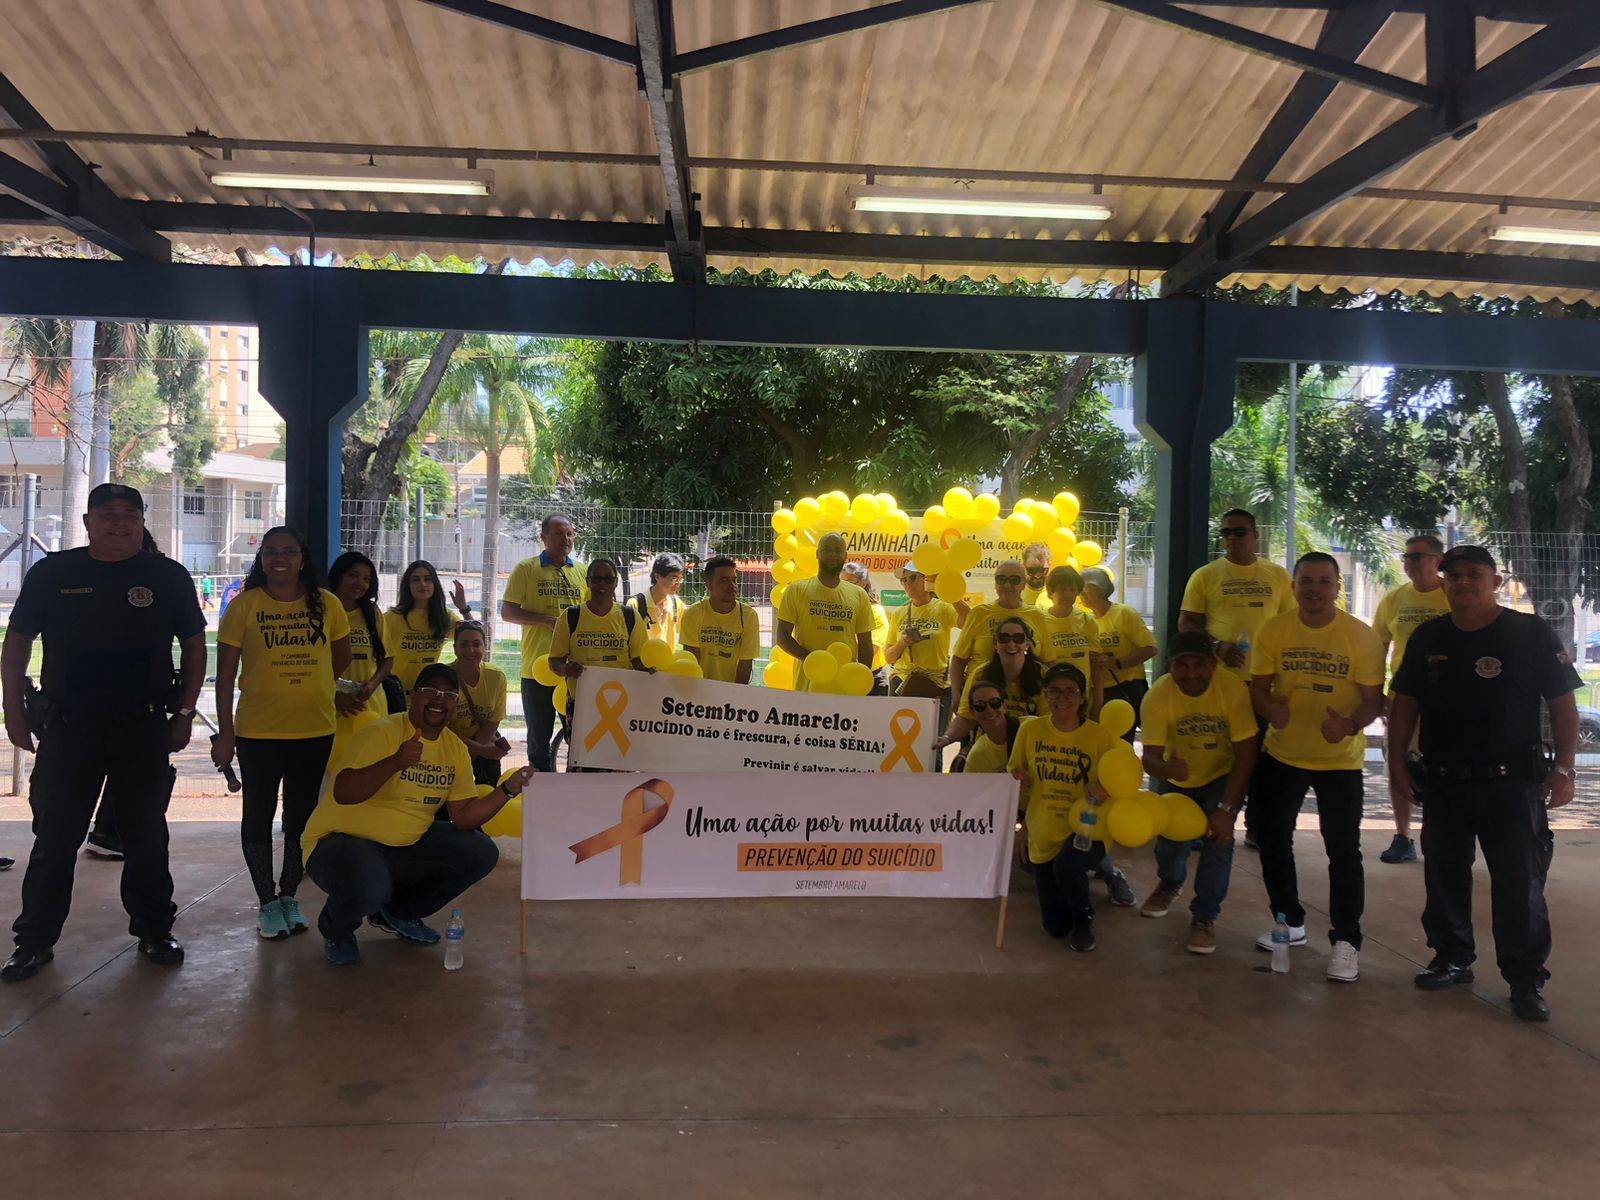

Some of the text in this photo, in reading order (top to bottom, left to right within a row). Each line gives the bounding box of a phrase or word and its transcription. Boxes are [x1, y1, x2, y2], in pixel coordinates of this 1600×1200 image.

[873, 558, 886, 570] DO
[256, 610, 283, 623] Uma
[264, 630, 311, 649] Vidas!
[661, 697, 859, 732] Setembro Amarelo:
[629, 719, 886, 754] SUICÍDIO não é frescura, é coisa SÉRIA!
[743, 757, 790, 771] Previnir
[794, 762, 799, 772] é
[685, 806, 995, 841] Uma ação por muitas vidas!
[745, 844, 936, 870] PREVENÇÃO DO SUICÍDIO
[795, 880, 867, 890] SETEMBRO AMARELO
